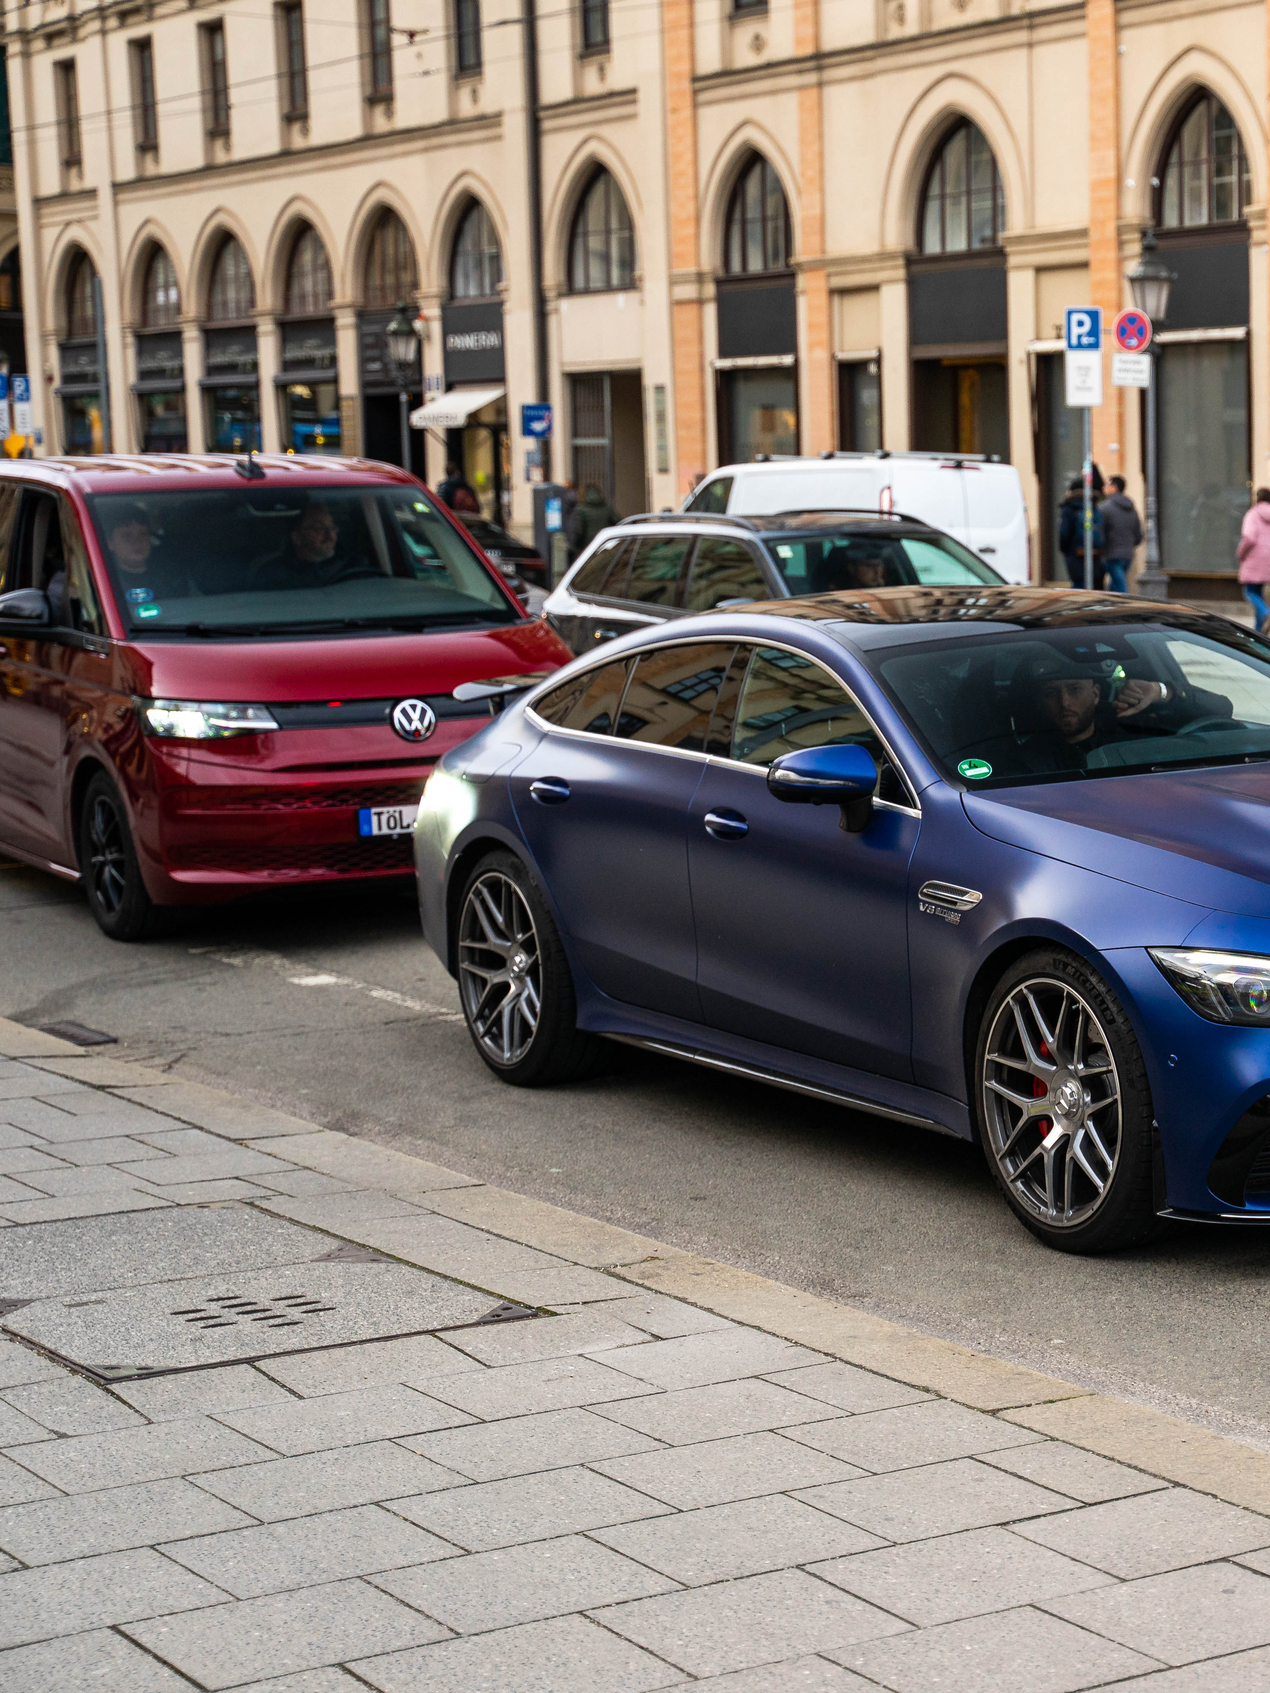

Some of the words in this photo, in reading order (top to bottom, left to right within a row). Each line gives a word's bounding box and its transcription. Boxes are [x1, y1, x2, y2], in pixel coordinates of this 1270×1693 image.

[1070, 312, 1092, 347] P
[373, 809, 410, 832] TÖL
[919, 902, 935, 914] V8
[1065, 966, 1115, 1022] MICHELIN
